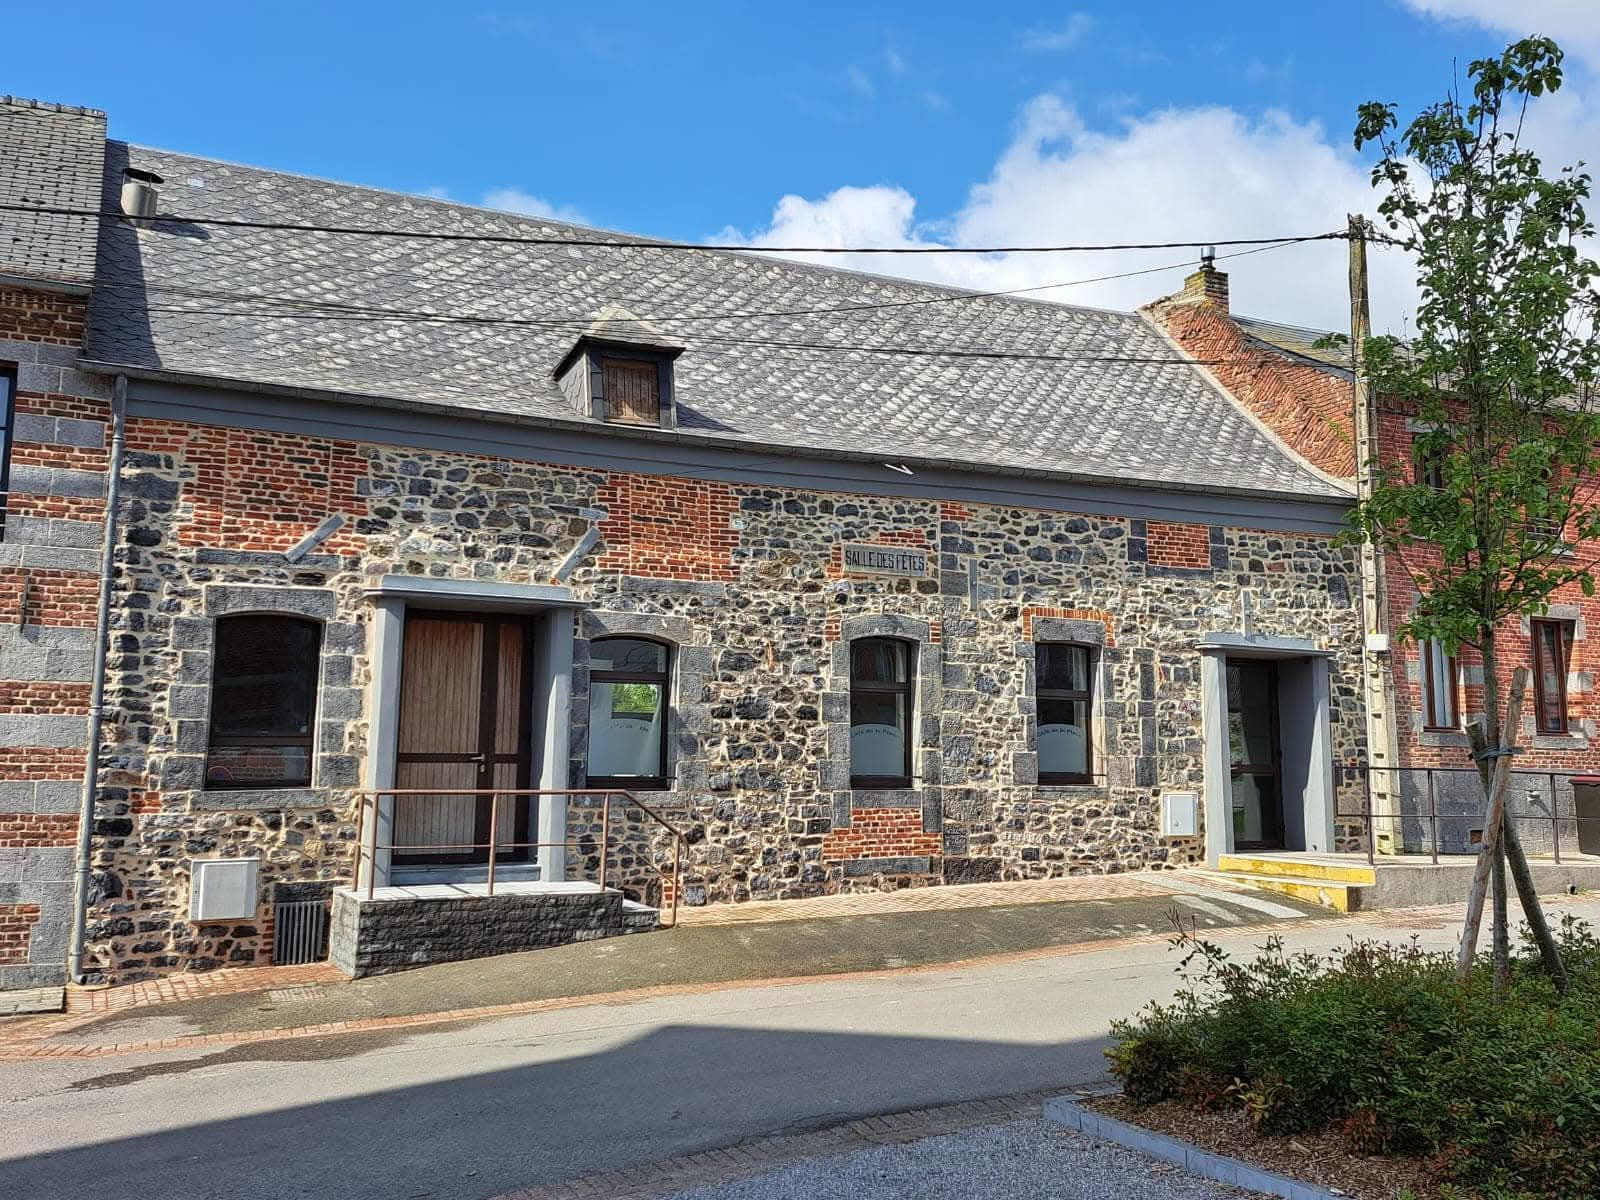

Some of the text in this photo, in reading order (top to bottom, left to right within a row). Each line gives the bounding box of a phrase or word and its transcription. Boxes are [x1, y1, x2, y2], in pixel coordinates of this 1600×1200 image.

[845, 550, 925, 571] SALLE DES FÊTES
